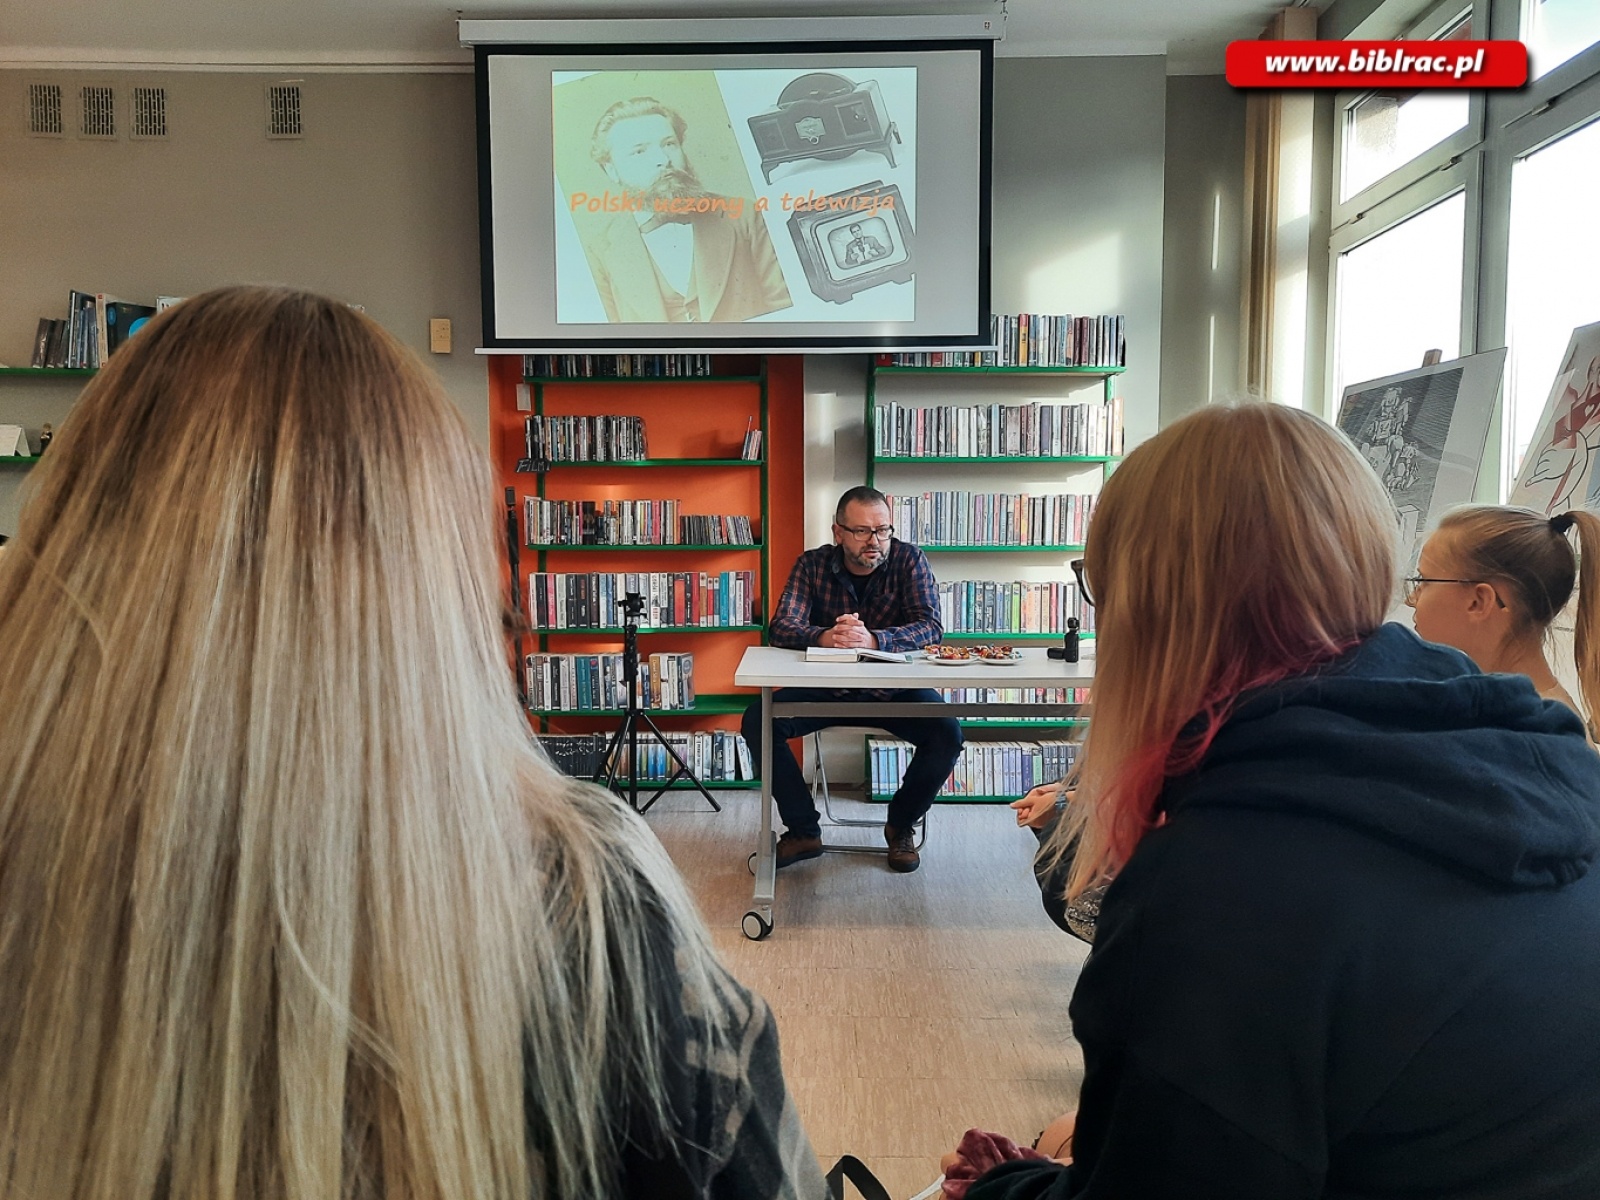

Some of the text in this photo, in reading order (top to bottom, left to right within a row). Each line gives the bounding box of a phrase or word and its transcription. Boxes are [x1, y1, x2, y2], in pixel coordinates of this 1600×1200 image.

[570, 189, 895, 219] Polski uczony a telewizja
